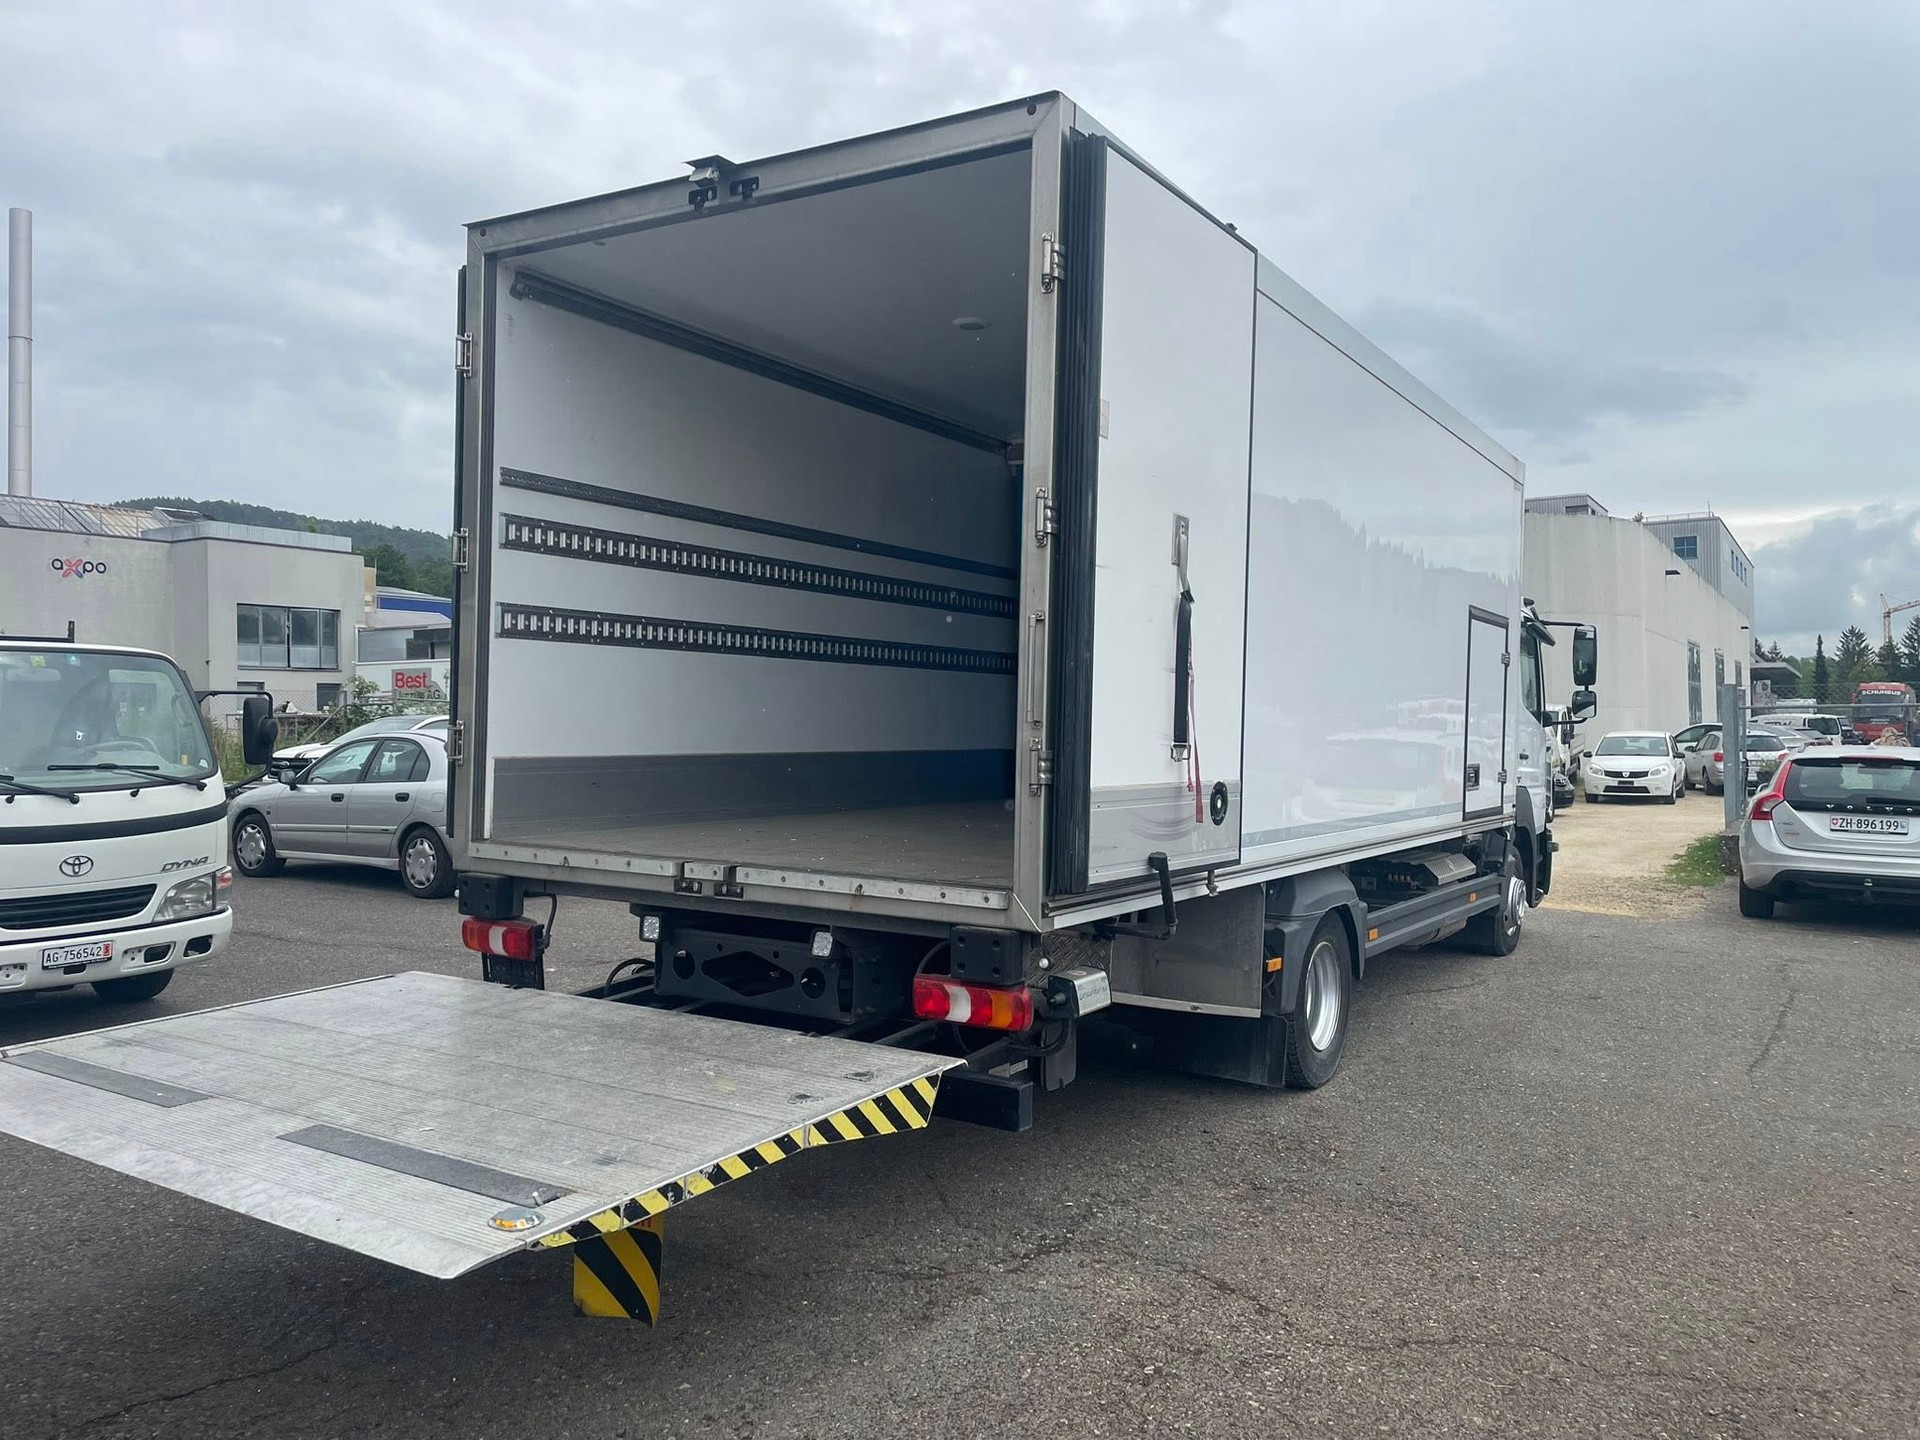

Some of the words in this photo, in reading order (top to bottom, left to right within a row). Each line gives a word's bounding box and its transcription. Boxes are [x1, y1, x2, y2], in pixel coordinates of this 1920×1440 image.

[51, 558, 107, 578] axpo
[395, 671, 427, 688] Best
[161, 856, 209, 871] DYNA
